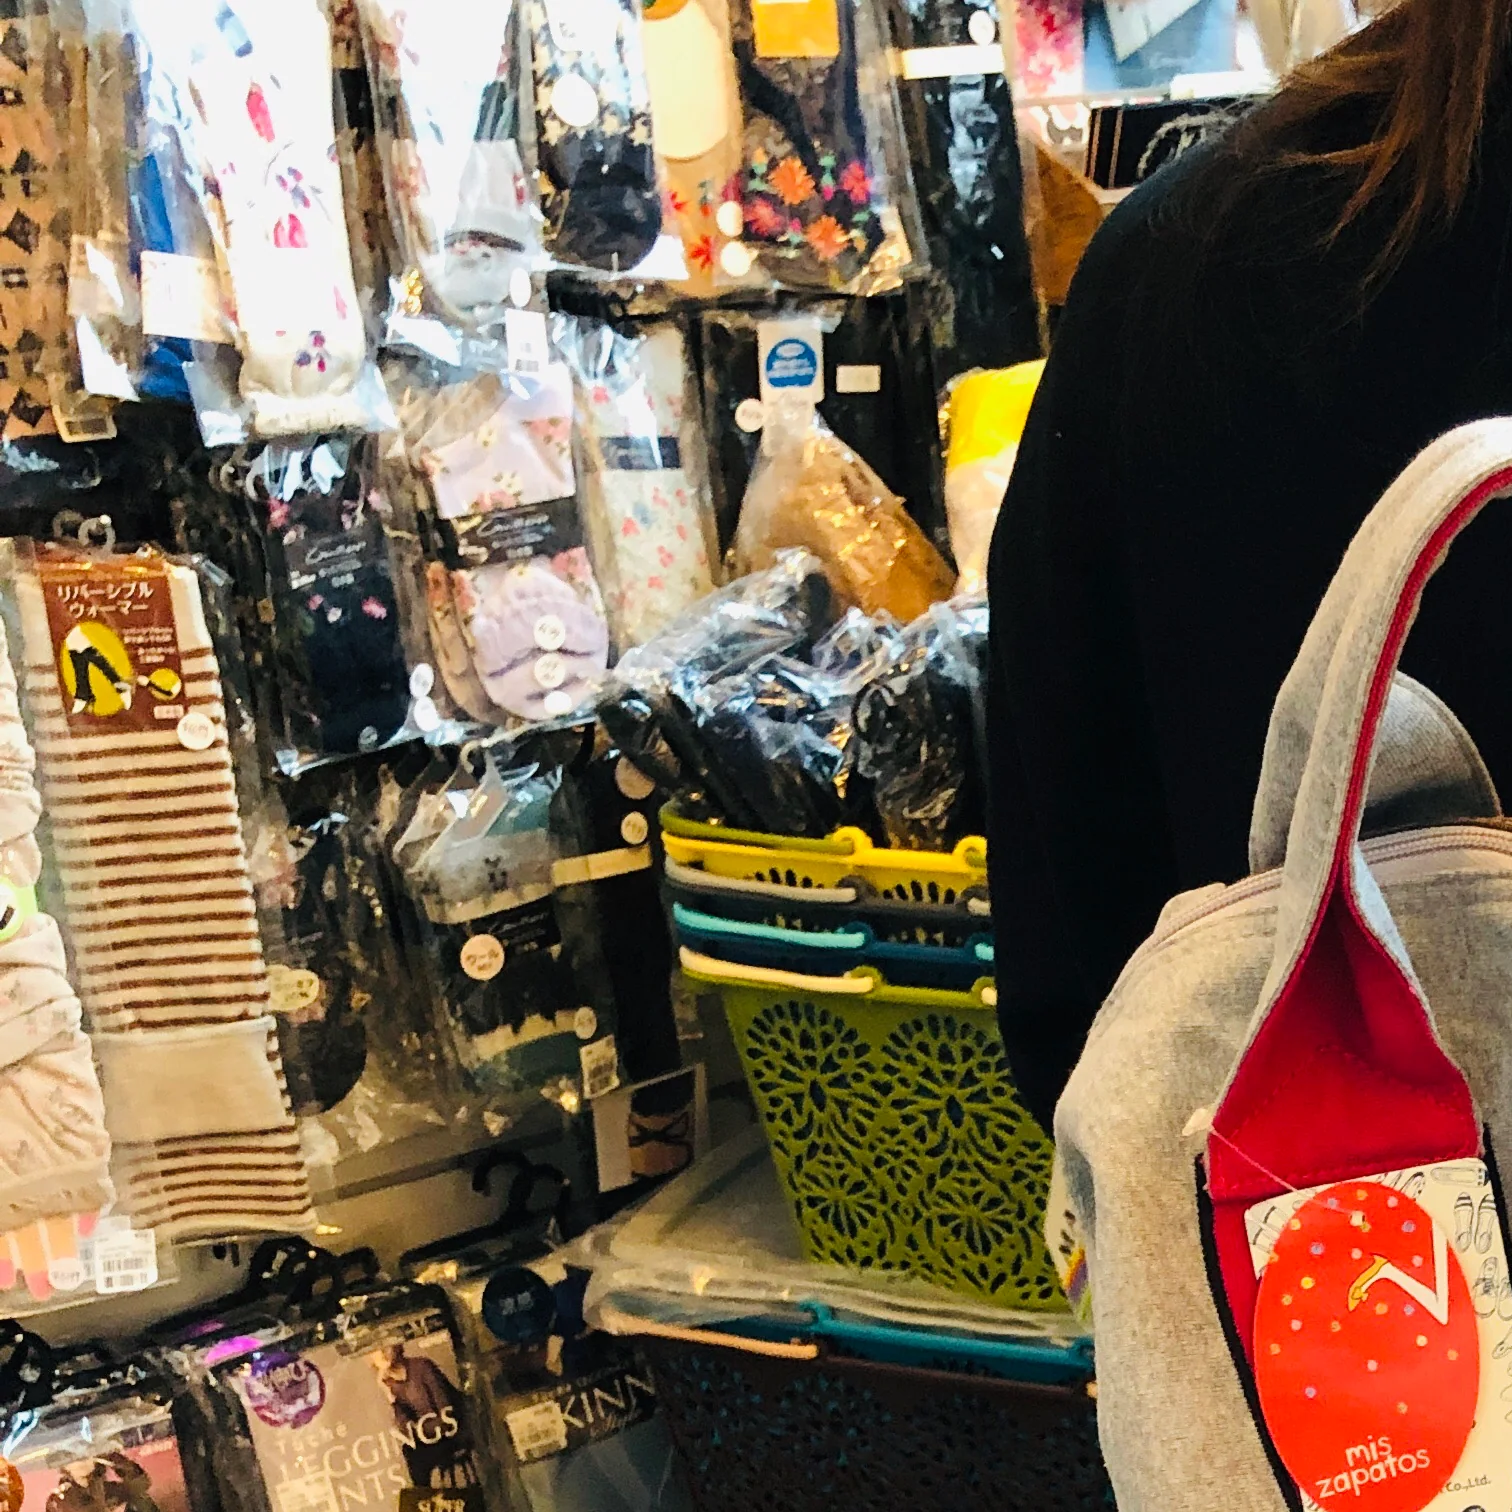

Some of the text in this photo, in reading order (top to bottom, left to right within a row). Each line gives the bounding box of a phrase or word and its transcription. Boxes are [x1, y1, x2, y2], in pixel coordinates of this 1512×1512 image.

[560, 1364, 656, 1429] KINN
[1315, 1449, 1431, 1498] zapatos
[1345, 1434, 1392, 1468] mis
[336, 1465, 407, 1512] NTS
